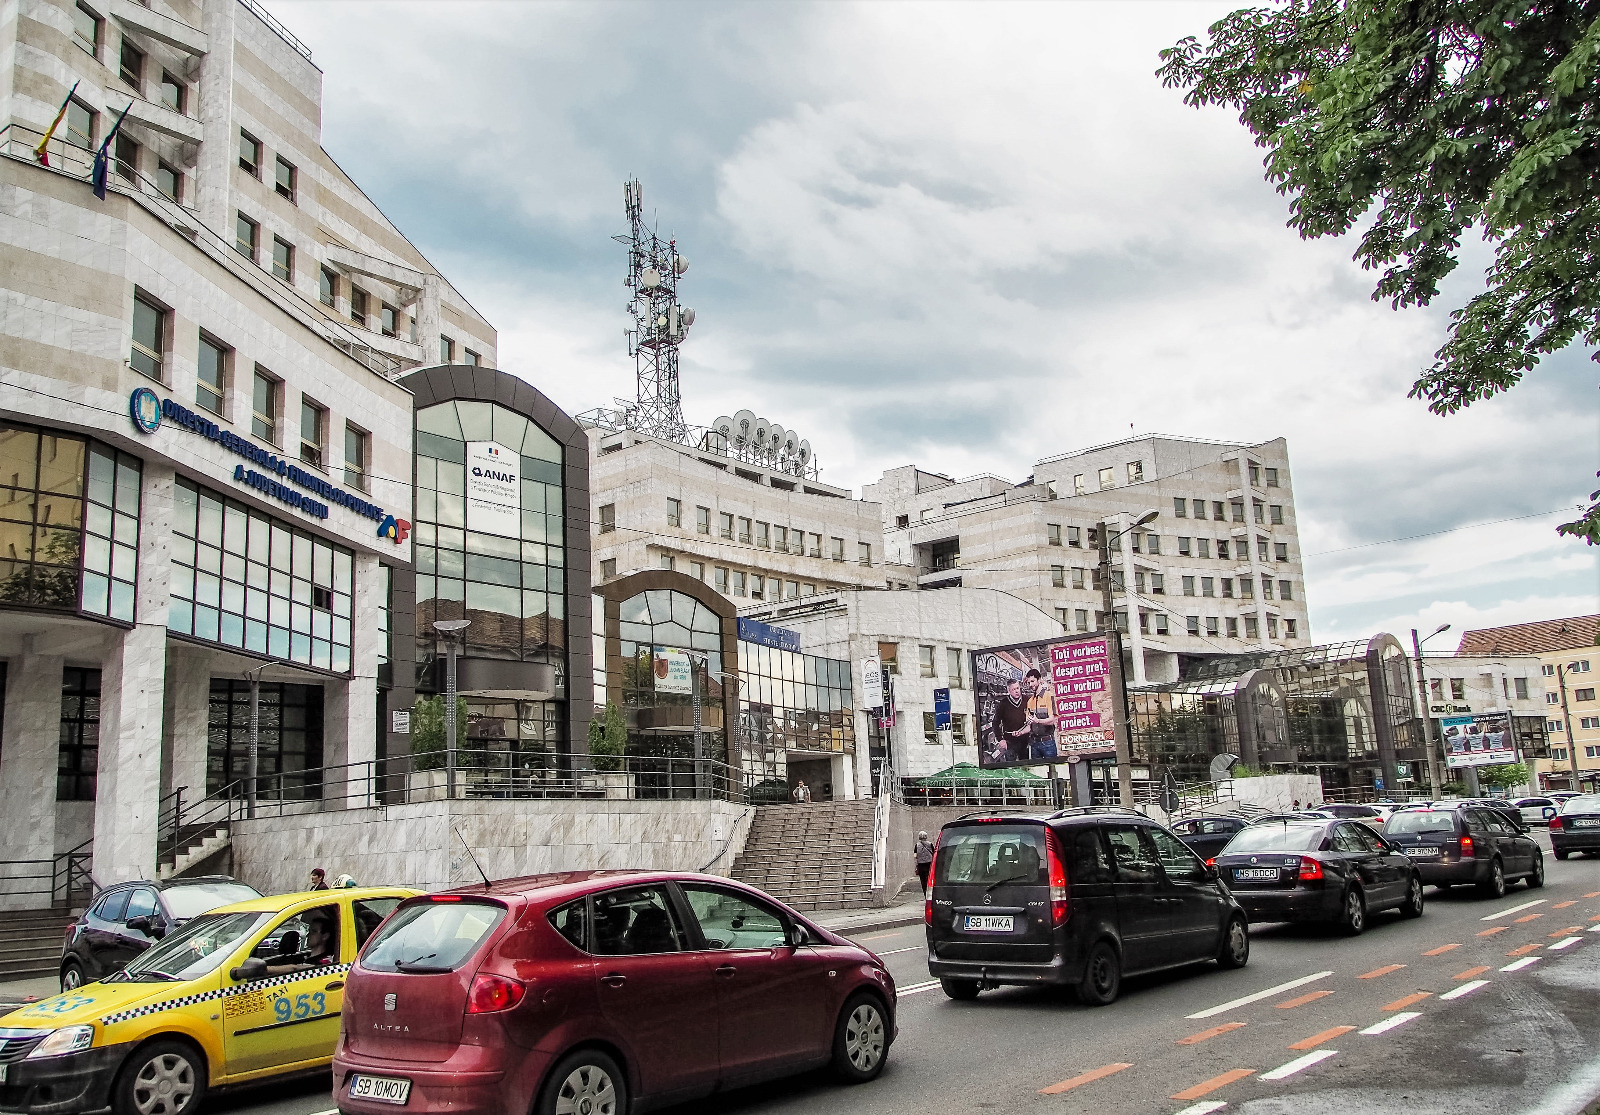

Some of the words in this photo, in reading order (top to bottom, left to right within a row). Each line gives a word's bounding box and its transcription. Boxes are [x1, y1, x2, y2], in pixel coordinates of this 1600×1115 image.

[483, 469, 516, 484] ANAF
[302, 496, 329, 520] SIBIU
[346, 493, 384, 522] PUBLICE
[1072, 644, 1105, 658] vorbesc
[1055, 665, 1084, 677] despre
[1057, 682, 1071, 695] Noi
[1073, 679, 1102, 692] vorbim
[1058, 700, 1087, 712] despre
[1060, 715, 1094, 731] proiect.
[1061, 731, 1104, 745] HORNBACH
[970, 917, 981, 928] SB
[265, 985, 288, 1002] TAXI
[274, 991, 326, 1022] 953
[373, 1023, 410, 1033] ALTEA
[356, 1079, 372, 1095] SB
